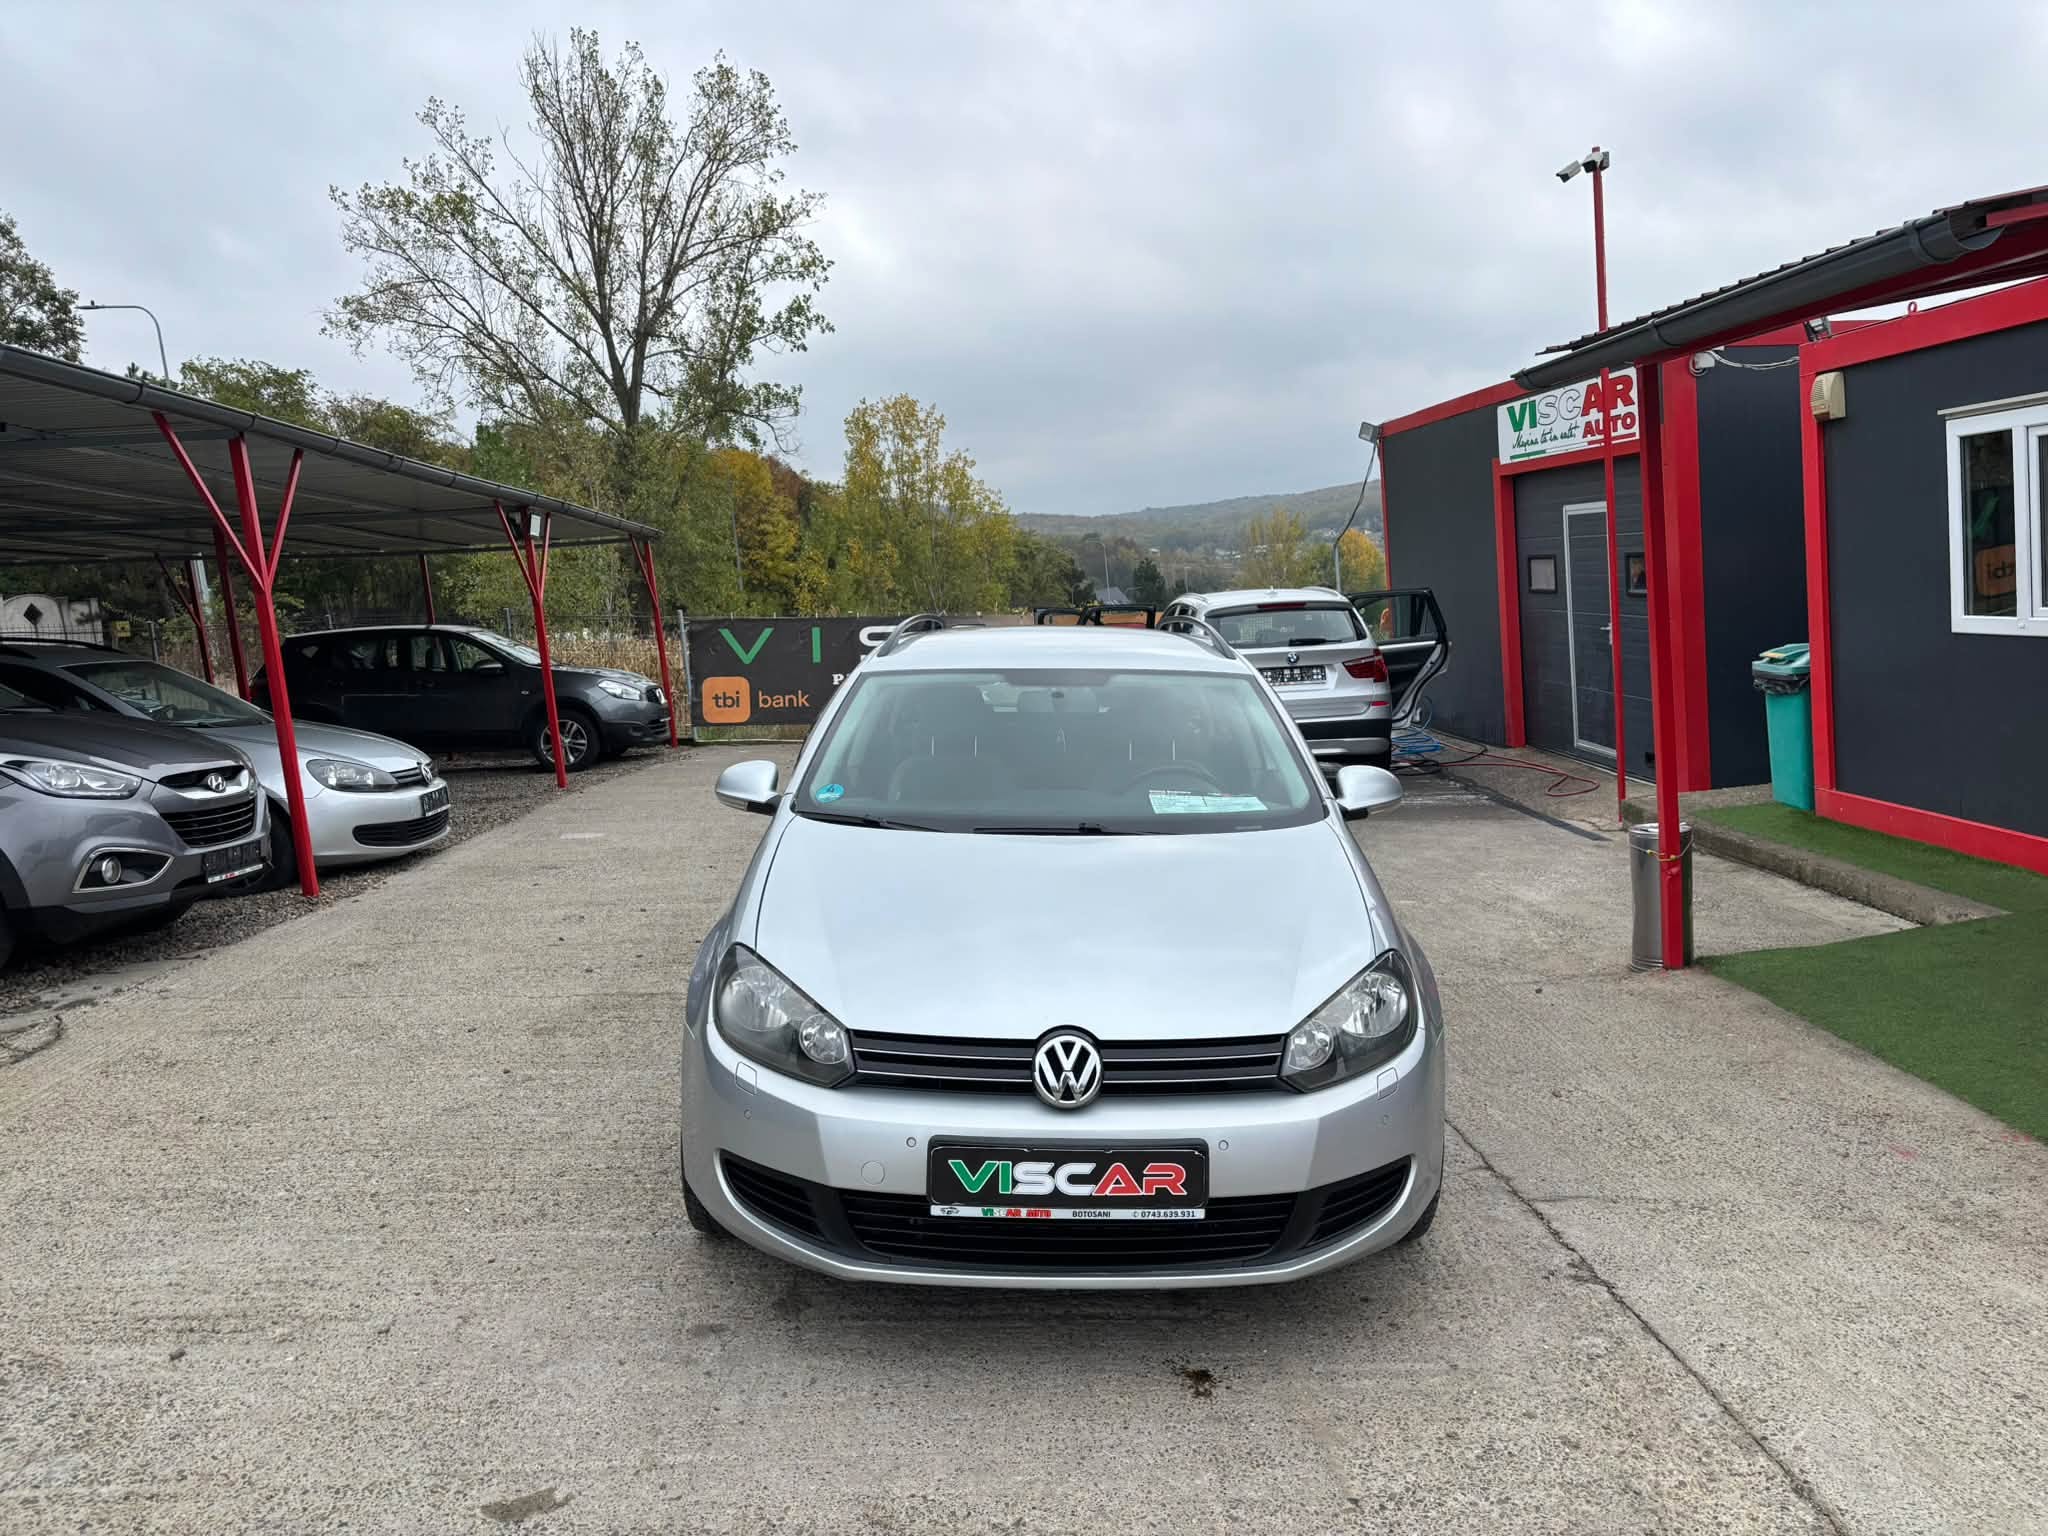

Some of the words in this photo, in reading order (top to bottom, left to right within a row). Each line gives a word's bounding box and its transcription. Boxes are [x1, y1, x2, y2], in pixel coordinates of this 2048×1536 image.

[1507, 375, 1636, 433] VISCAR
[1582, 412, 1636, 439] AUTO
[712, 691, 741, 709] tbi
[758, 690, 810, 709] bank
[948, 1159, 1188, 1197] VISCAR
[1072, 1210, 1111, 1218] BOTOSANI
